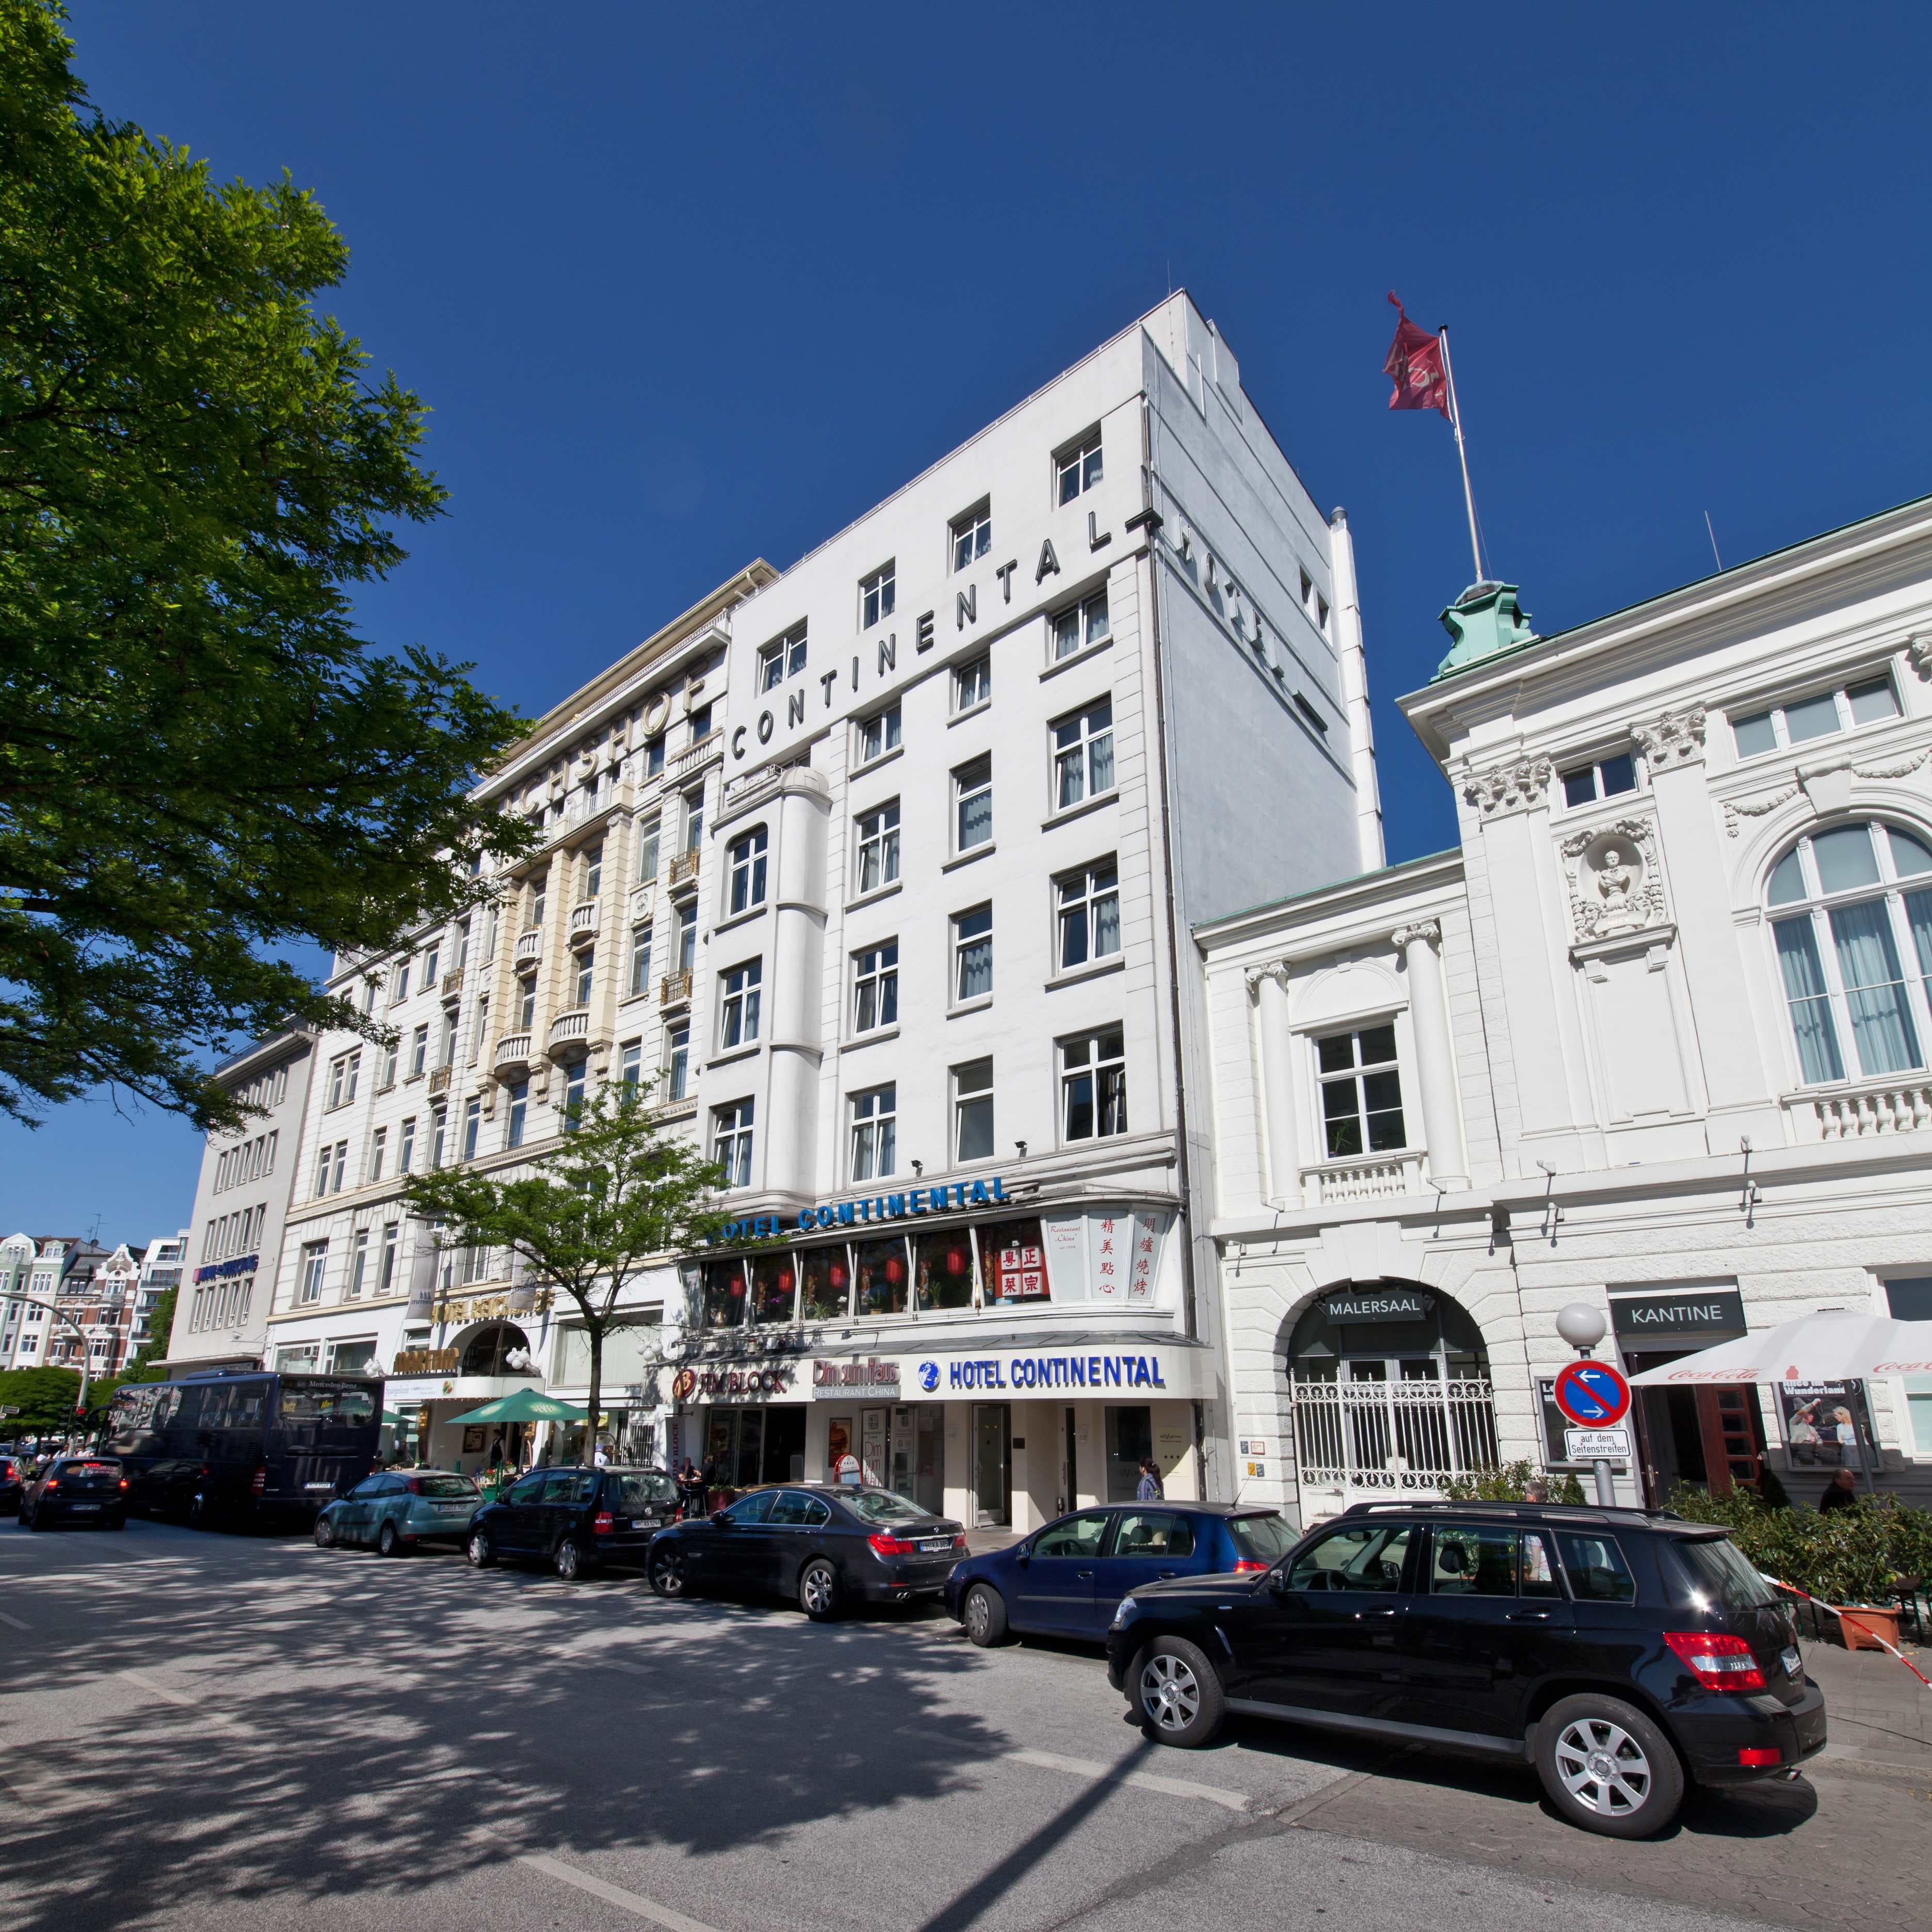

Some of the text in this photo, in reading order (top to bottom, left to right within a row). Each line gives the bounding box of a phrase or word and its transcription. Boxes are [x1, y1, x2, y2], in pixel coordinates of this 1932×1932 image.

[731, 511, 1112, 760] CONTINENTAL
[706, 1177, 1011, 1245] OTEL CONTINENTAL
[1329, 1298, 1420, 1316] MALERSAAL
[1631, 1305, 1723, 1324] KANTINE
[867, 1357, 899, 1383] Haus
[951, 1356, 1165, 1387] HOTEL CONTINENTAL
[1668, 1367, 1766, 1381] Coca-Cola
[309, 1380, 357, 1389] Mercedes-Benz
[698, 1369, 787, 1393] JIM BLOCK
[1784, 1387, 1846, 1395] Wunderland
[1581, 1434, 1614, 1442] auf dem
[1571, 1443, 1627, 1454] Seitenstreifen
